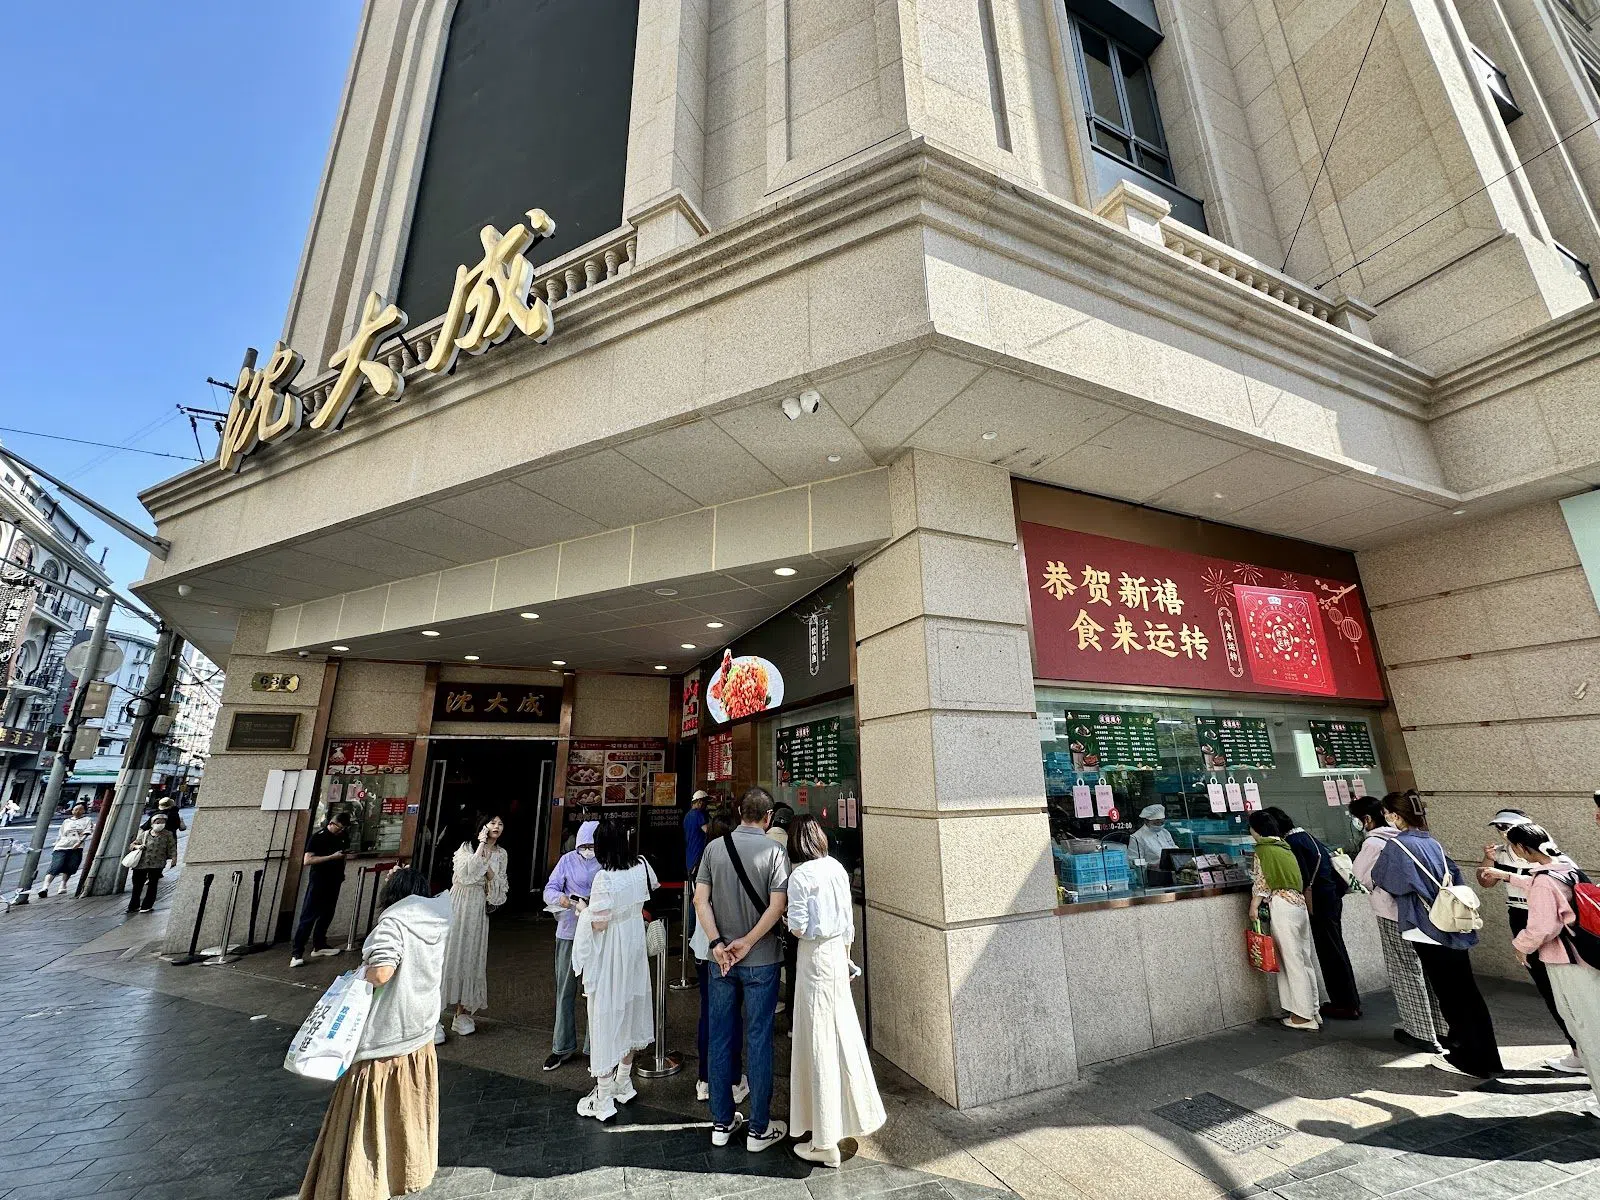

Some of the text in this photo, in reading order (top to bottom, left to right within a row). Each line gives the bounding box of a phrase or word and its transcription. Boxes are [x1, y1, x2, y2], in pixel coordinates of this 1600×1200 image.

[219, 208, 556, 474] 沈大成
[1041, 560, 1185, 616] 恭贺新禧
[1068, 608, 1210, 661] 食来运转
[1223, 620, 1238, 662] 食来运转
[260, 675, 291, 686] 636
[445, 690, 545, 716] 沈大成
